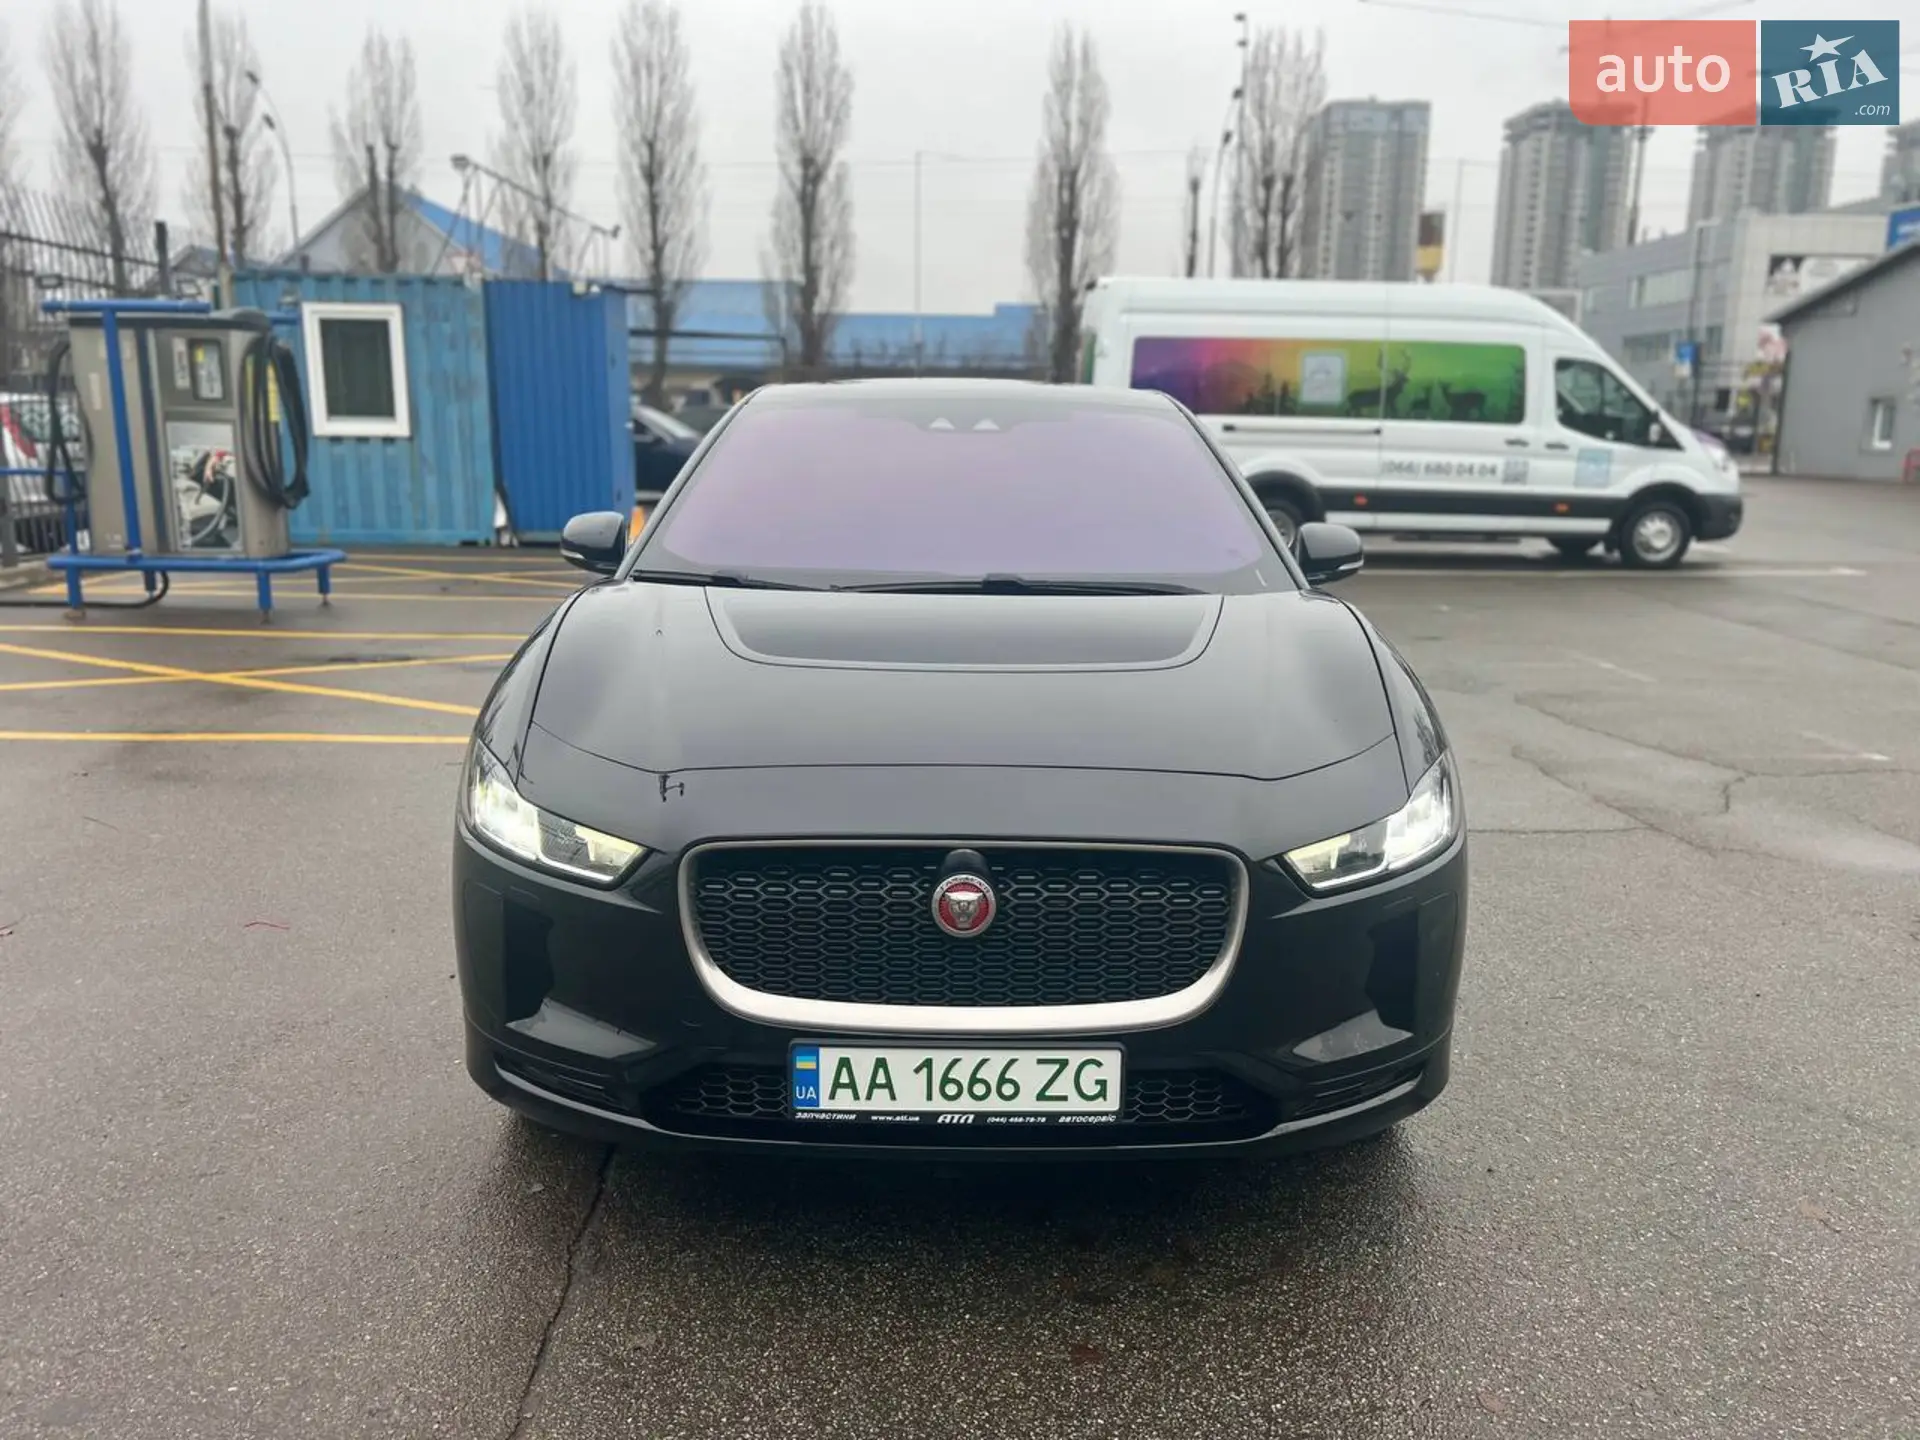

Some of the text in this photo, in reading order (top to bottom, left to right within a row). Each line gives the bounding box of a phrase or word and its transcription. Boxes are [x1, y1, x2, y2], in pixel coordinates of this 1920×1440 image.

[796, 1086, 817, 1100] UA
[828, 1057, 1109, 1102] AA 1666 ZG
